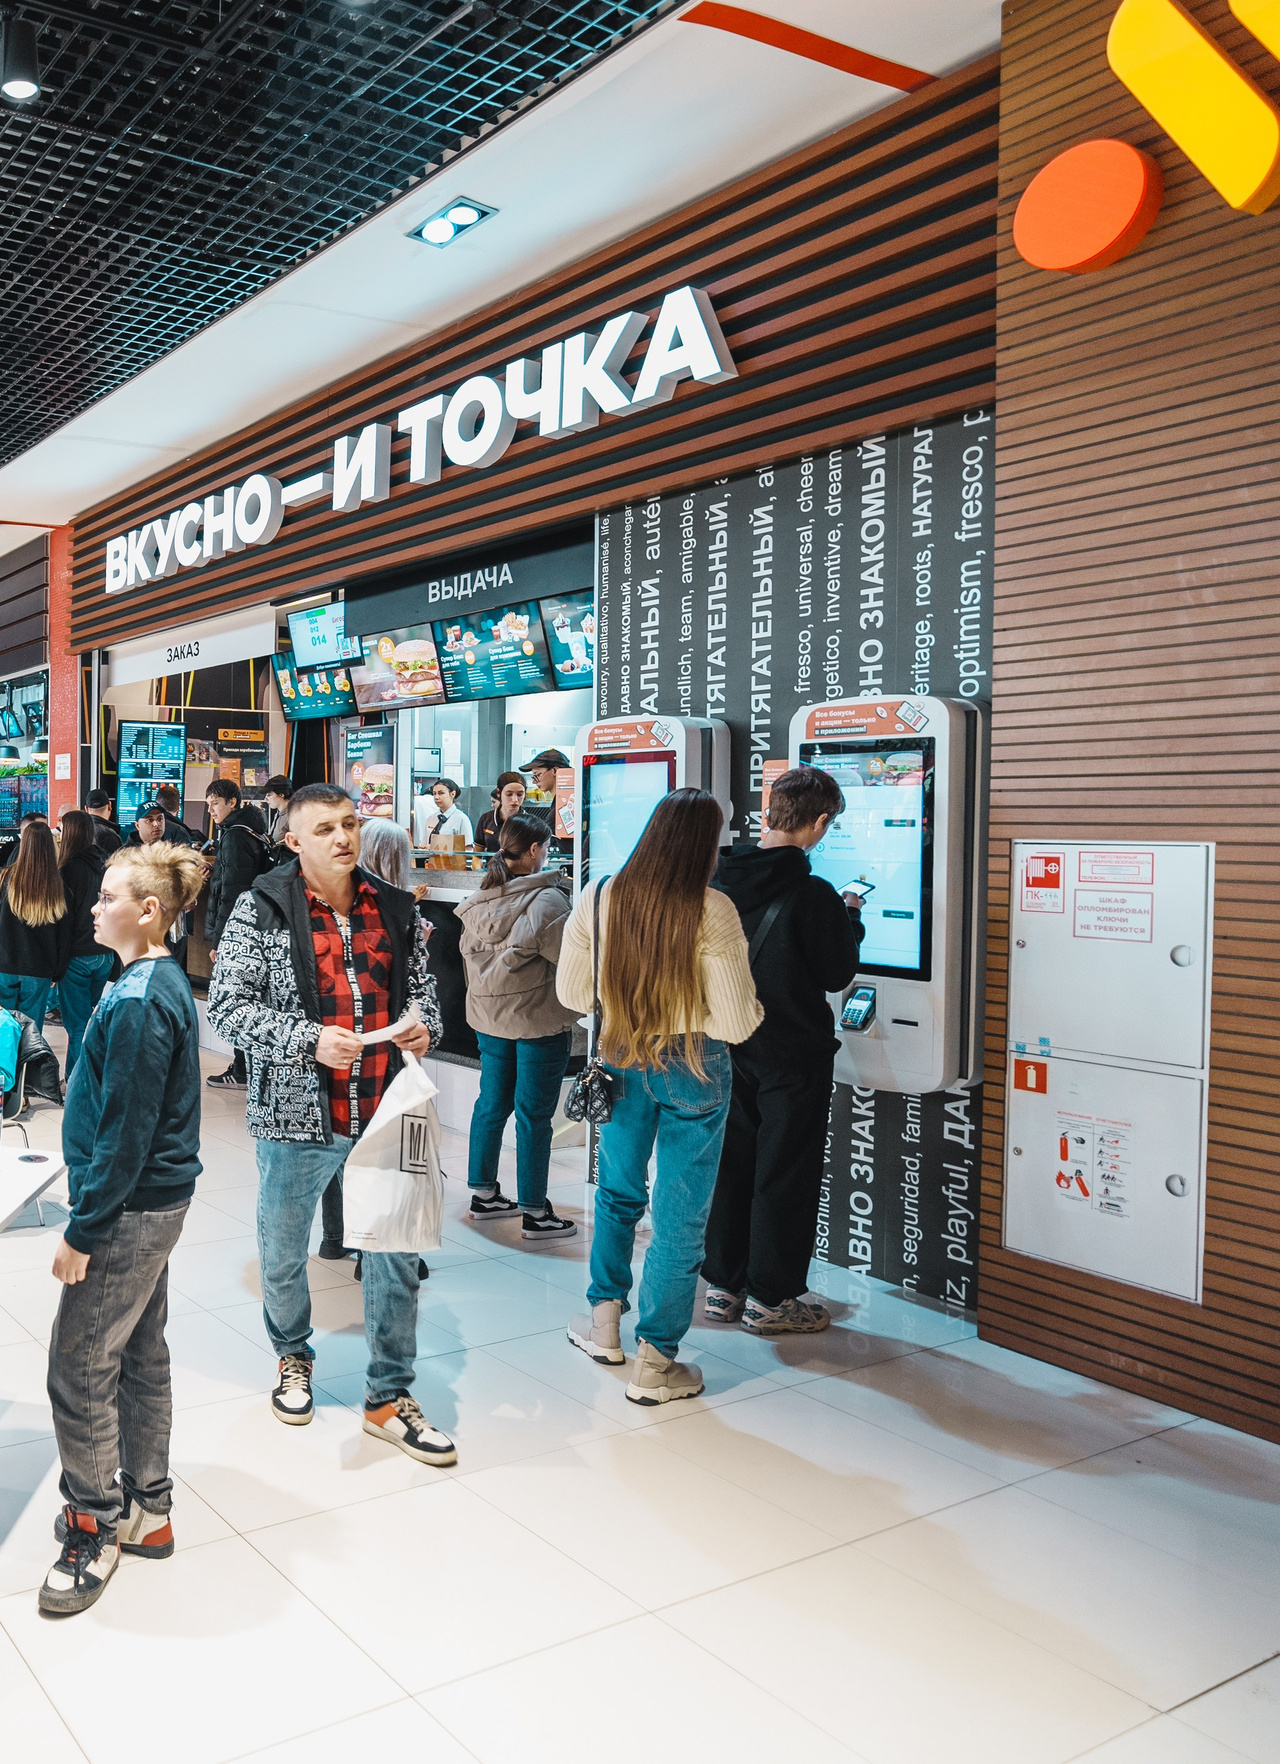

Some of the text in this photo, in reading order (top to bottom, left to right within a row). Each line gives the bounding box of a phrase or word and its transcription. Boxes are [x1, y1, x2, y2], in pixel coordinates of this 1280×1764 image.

[398, 285, 734, 484] ТОЧКА
[954, 435, 988, 542] fresco,
[679, 492, 697, 584] amigable,
[857, 435, 886, 630] ЗНАКОМЫЙ
[428, 563, 513, 603] ВЫДАЧА
[795, 518, 815, 617] universal,
[823, 523, 844, 622] inventive,
[912, 543, 934, 606] roots,
[311, 634, 327, 647] 014
[620, 577, 632, 662] ЗНАКОМЫЙ,
[637, 569, 663, 716] АЛЬНЫЙ,
[678, 589, 695, 643] team,
[953, 550, 987, 698] optimism,
[166, 641, 200, 663] ЗАКАЗ
[794, 624, 814, 693] fresco,
[600, 667, 610, 716] savoury,
[620, 665, 631, 714] ДАВНО
[1077, 905, 1149, 915] ОПЛОМБИРОВАН
[1093, 925, 1146, 934] ТРЕБУЮТСЯ
[345, 967, 363, 1017] TAKE MORE ELSE
[349, 1082, 359, 1136] TAKE MORE ELSE
[900, 1152, 924, 1266] seguridad,
[940, 1159, 975, 1266] playful,
